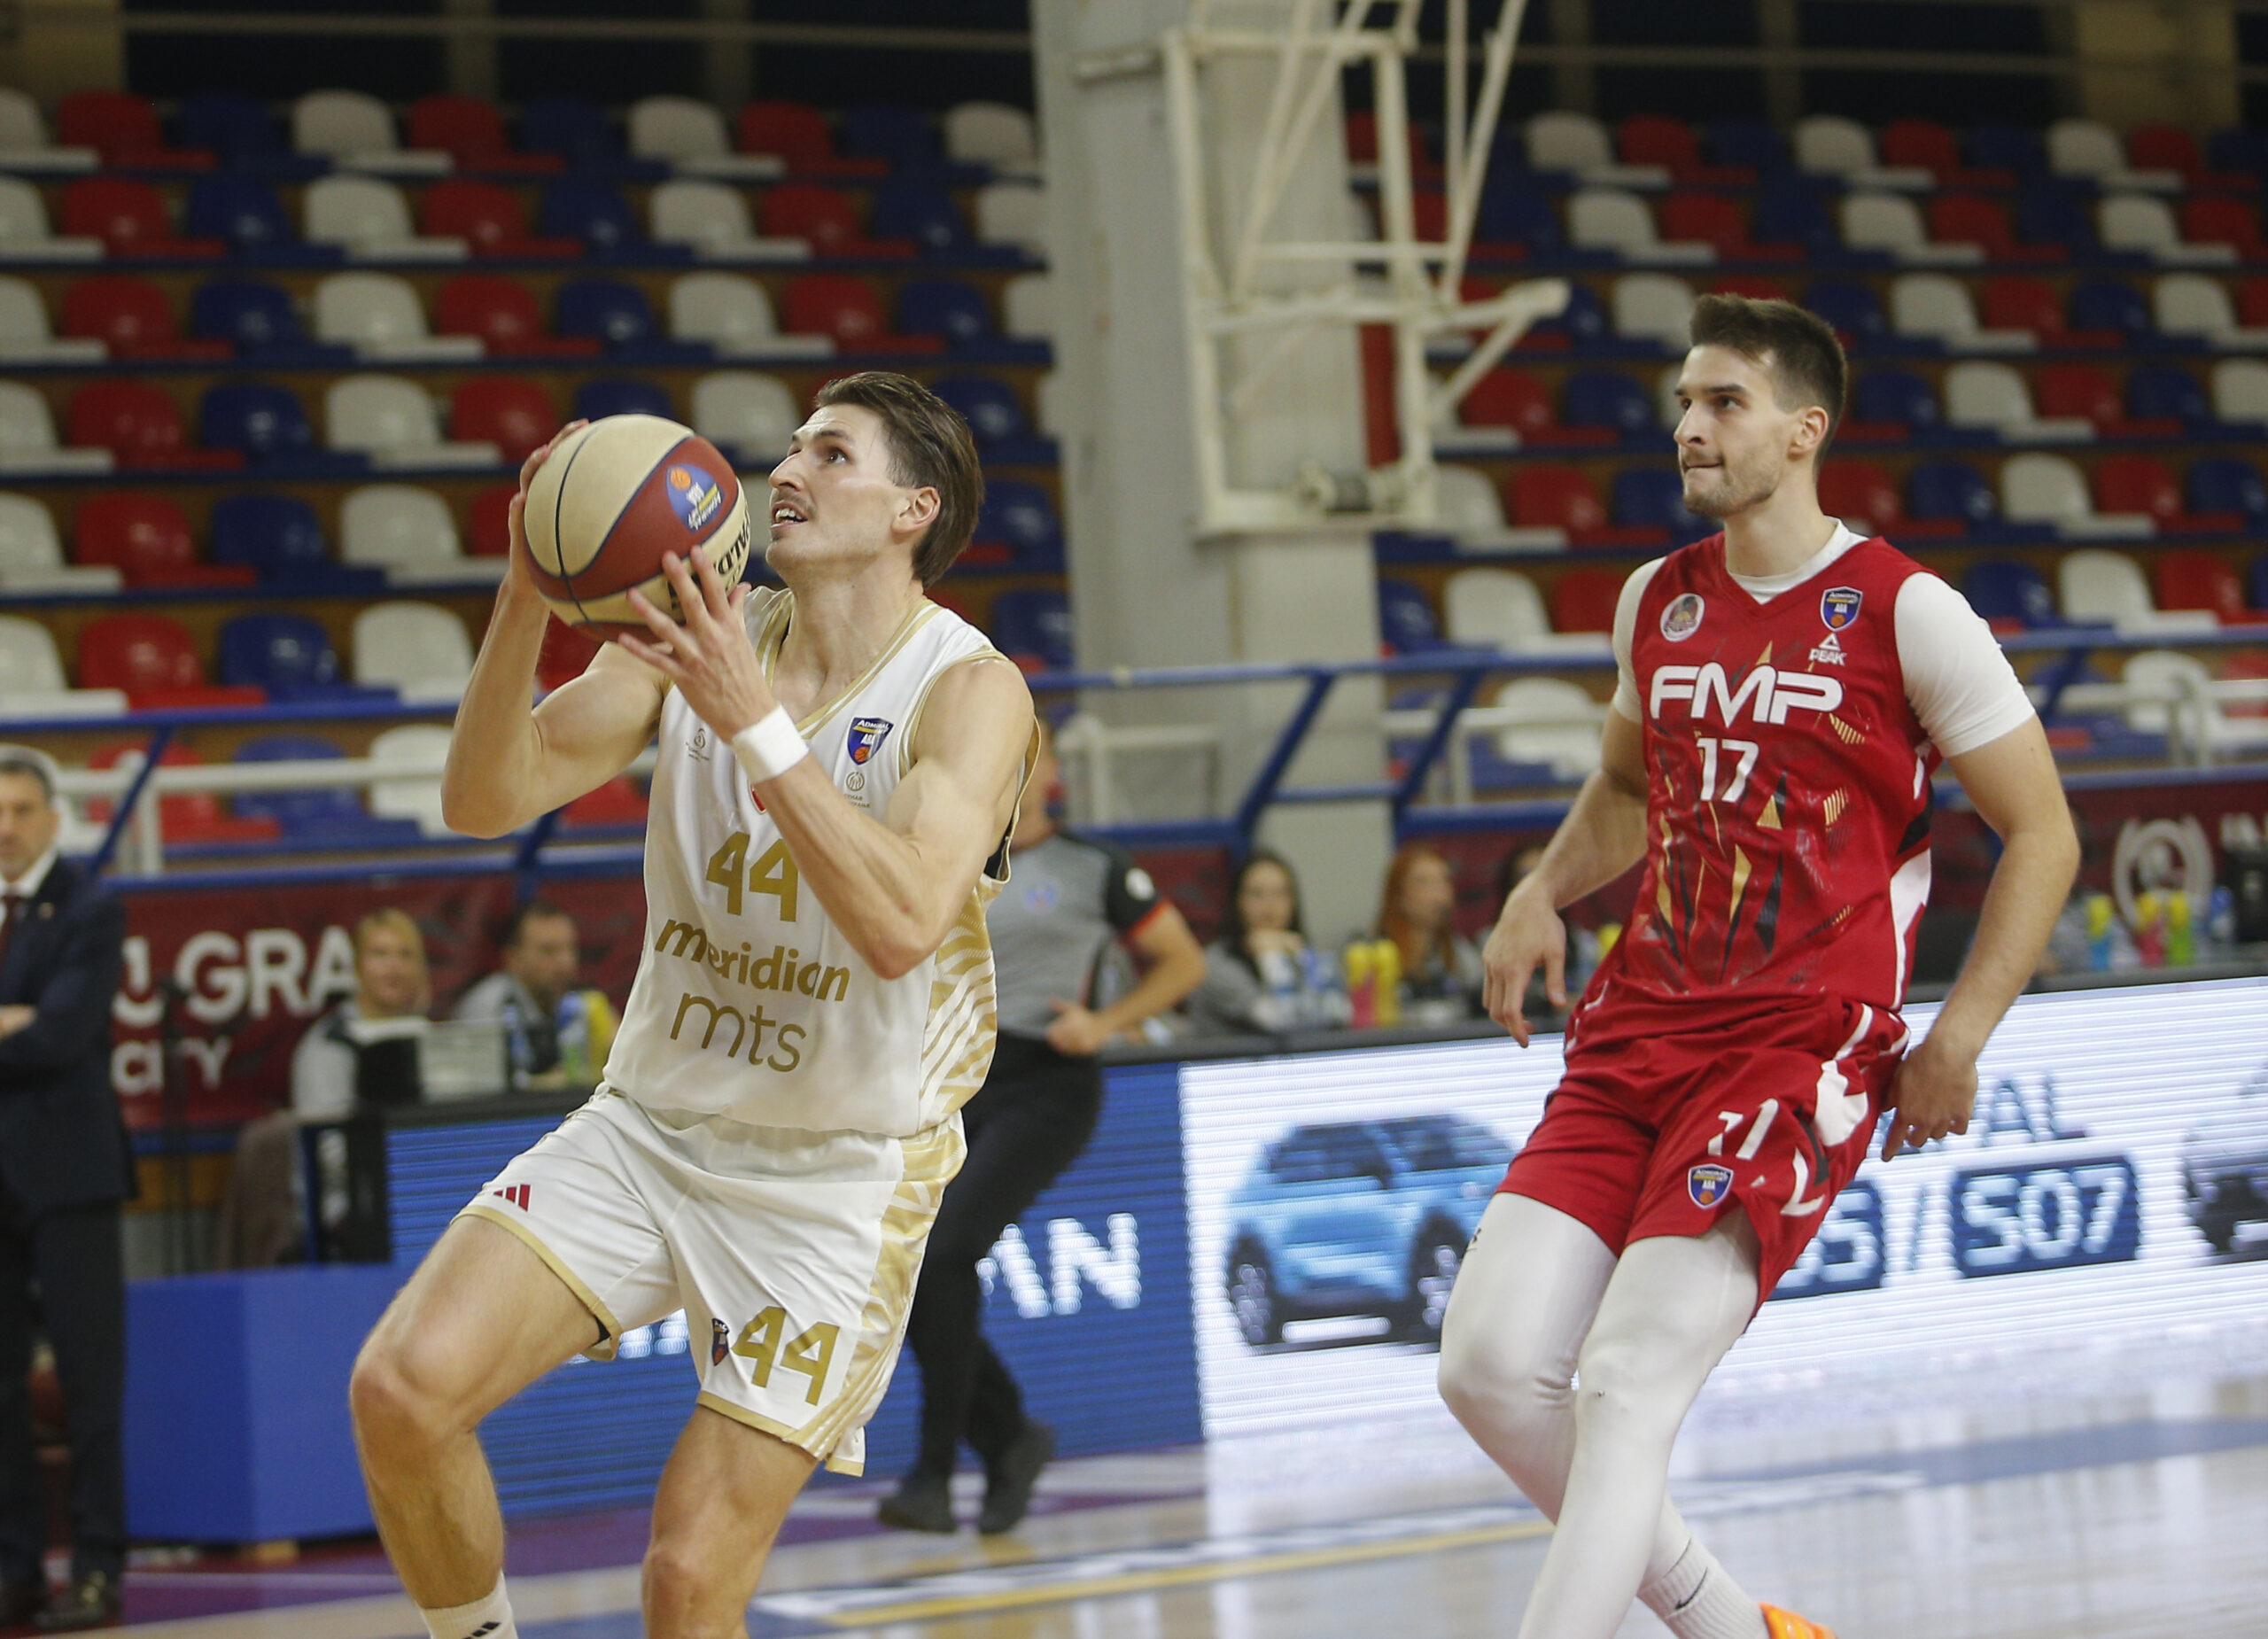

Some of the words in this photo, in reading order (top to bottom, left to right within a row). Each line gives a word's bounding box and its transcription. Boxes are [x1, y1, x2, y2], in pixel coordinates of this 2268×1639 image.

[1650, 662, 1844, 728] FMP
[1808, 648, 1848, 666] PEAK
[1697, 737, 1759, 803] 17
[706, 831, 799, 922] 44
[174, 926, 359, 1024] GRA
[655, 919, 850, 1002] meridian
[669, 990, 806, 1073] mts
[1961, 1163, 2125, 1268] S07
[975, 1213, 1141, 1318] AN
[732, 1306, 841, 1406] 44
